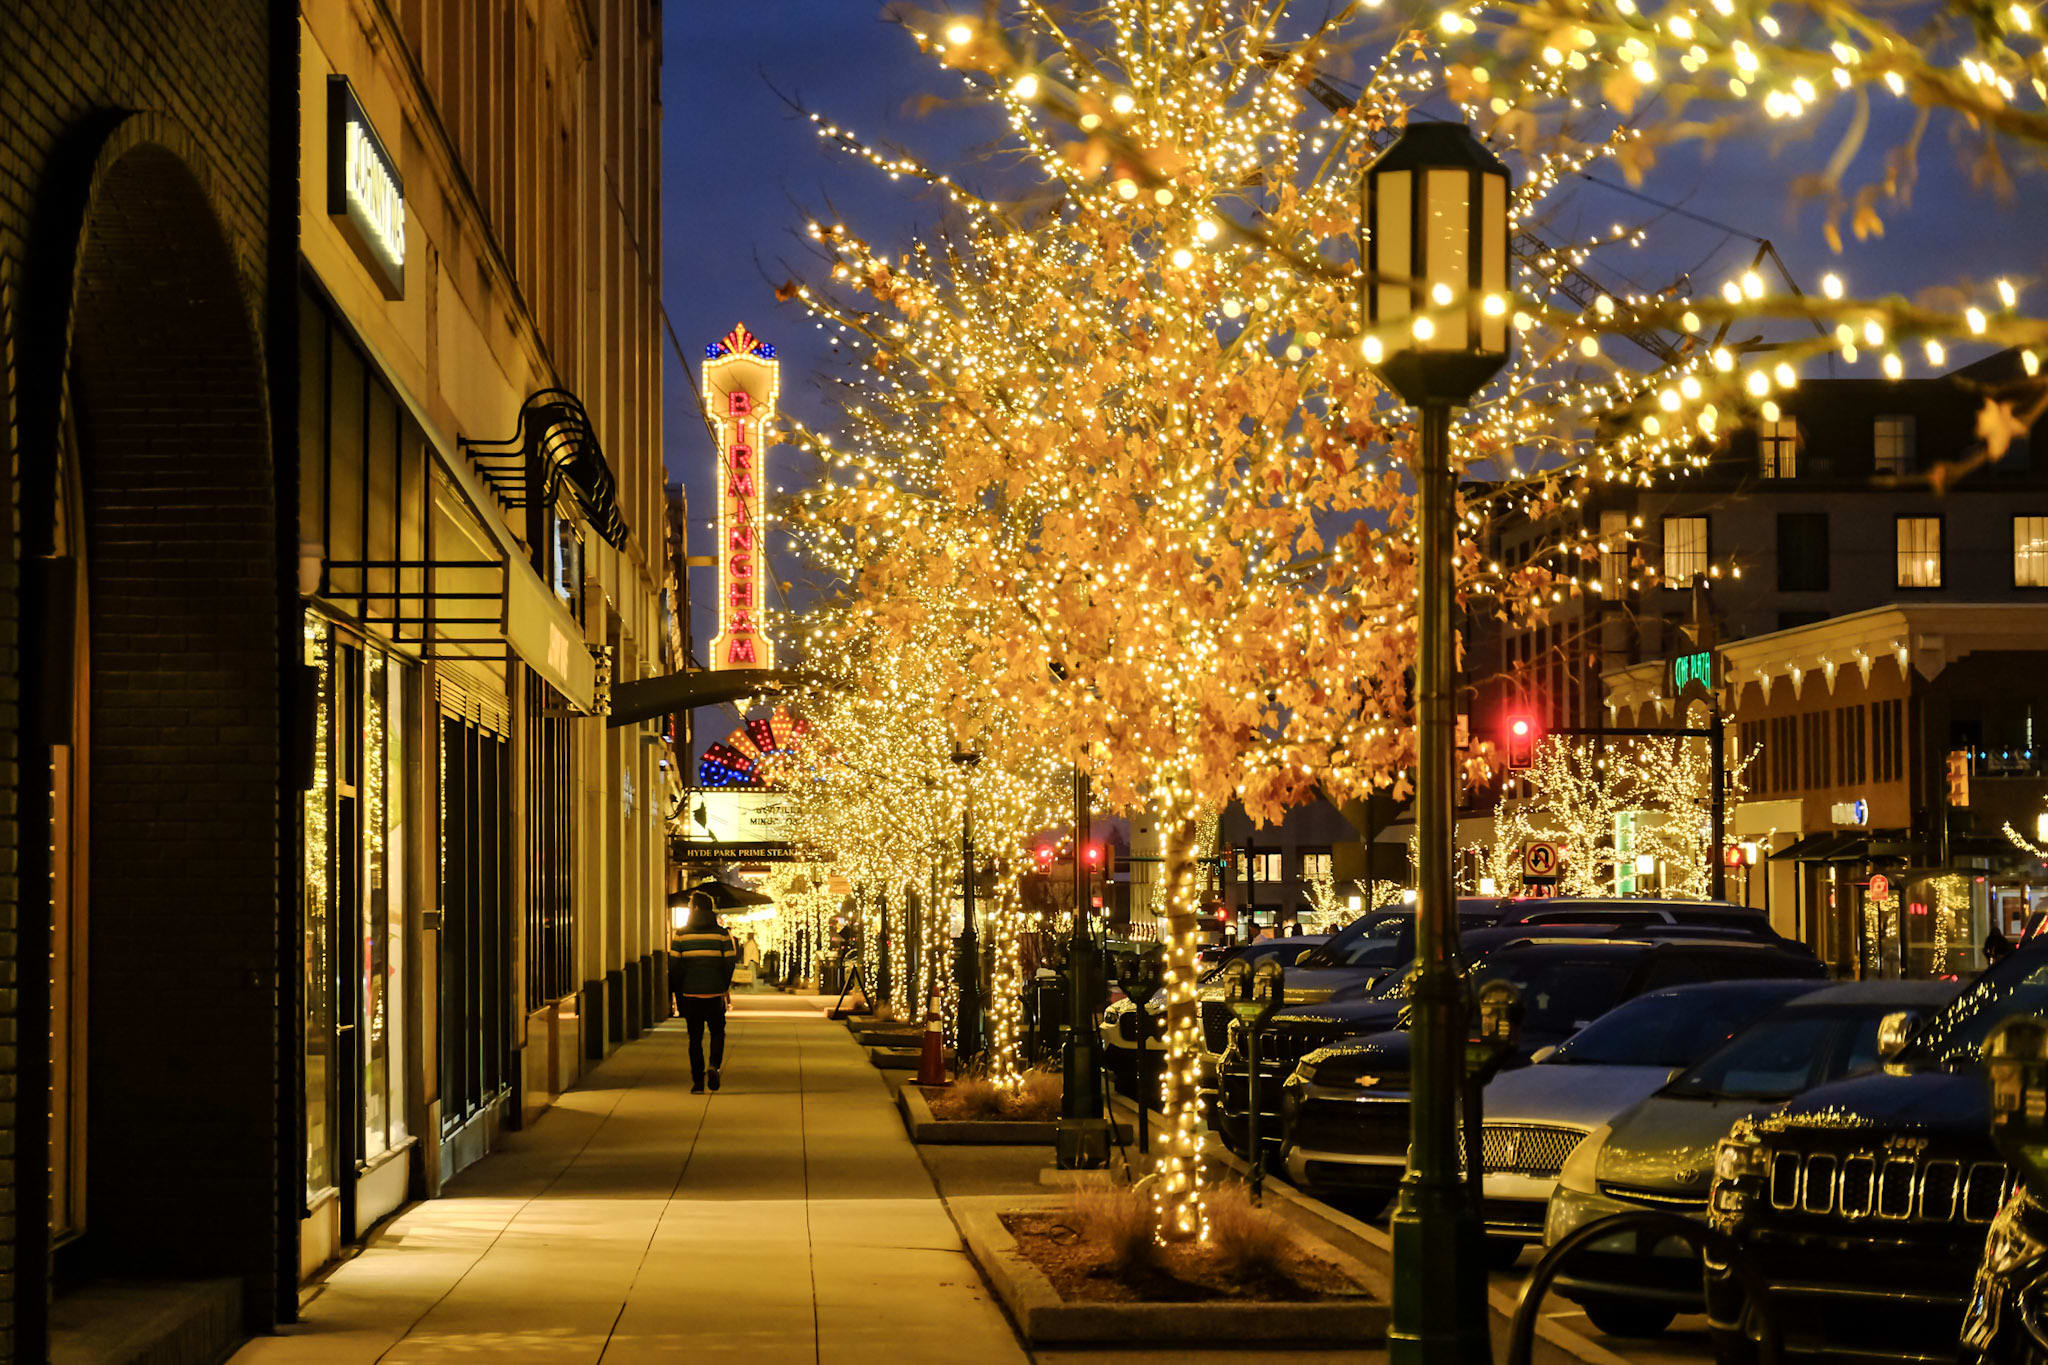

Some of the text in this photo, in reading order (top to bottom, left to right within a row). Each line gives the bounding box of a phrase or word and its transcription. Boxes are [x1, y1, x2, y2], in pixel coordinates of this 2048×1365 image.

[728, 392, 757, 664] BIRMINGHAM
[687, 849, 712, 857] HYDE
[714, 849, 736, 857] PARK
[738, 849, 765, 857] PRIME
[1882, 1135, 1929, 1156] Jeep
